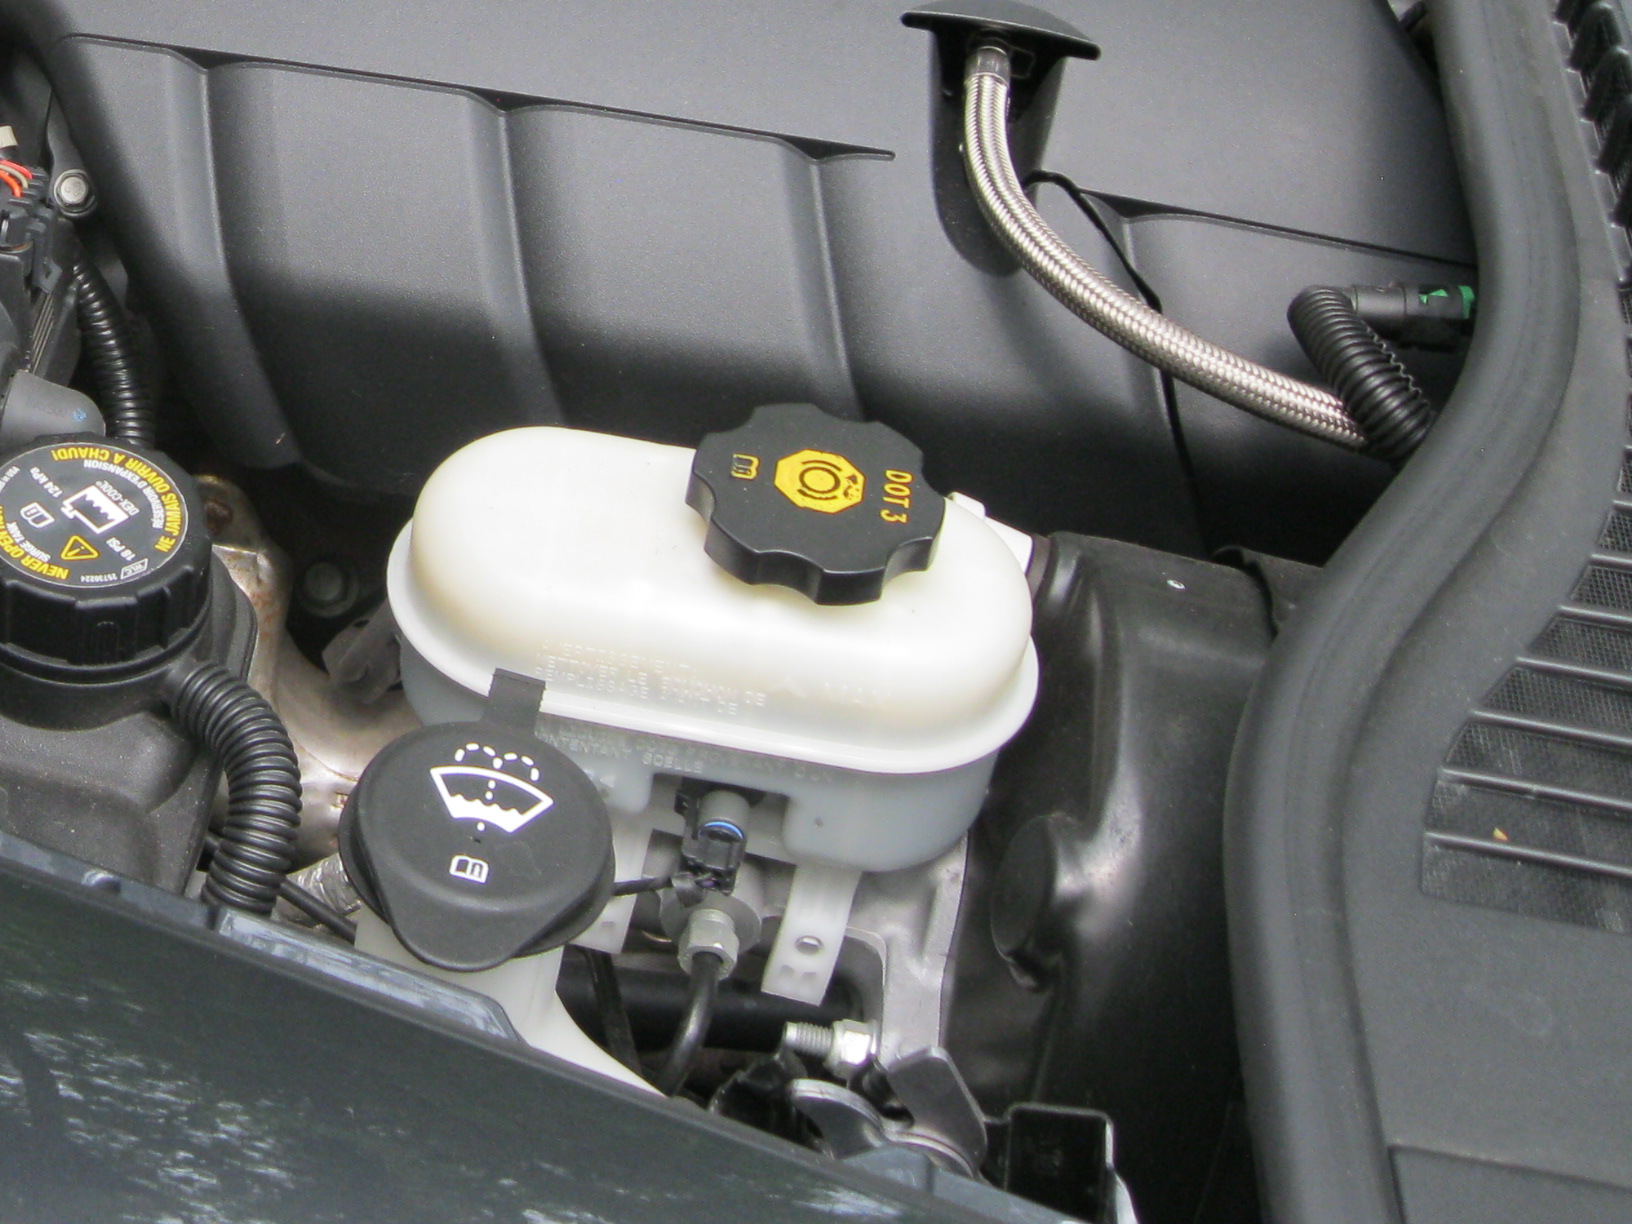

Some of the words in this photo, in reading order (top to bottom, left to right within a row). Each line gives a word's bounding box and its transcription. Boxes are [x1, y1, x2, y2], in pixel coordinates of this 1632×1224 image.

[50, 447, 110, 461] CHAUD!
[124, 457, 171, 493] OUVRIR
[882, 469, 912, 508] DOT
[161, 492, 182, 537] JAMAIS
[880, 509, 907, 523] 3
[6, 521, 25, 544] TANK
[154, 535, 176, 553] NE
[19, 539, 51, 563] SURGE
[106, 537, 126, 552] PSI
[20, 555, 69, 580] NEVER
